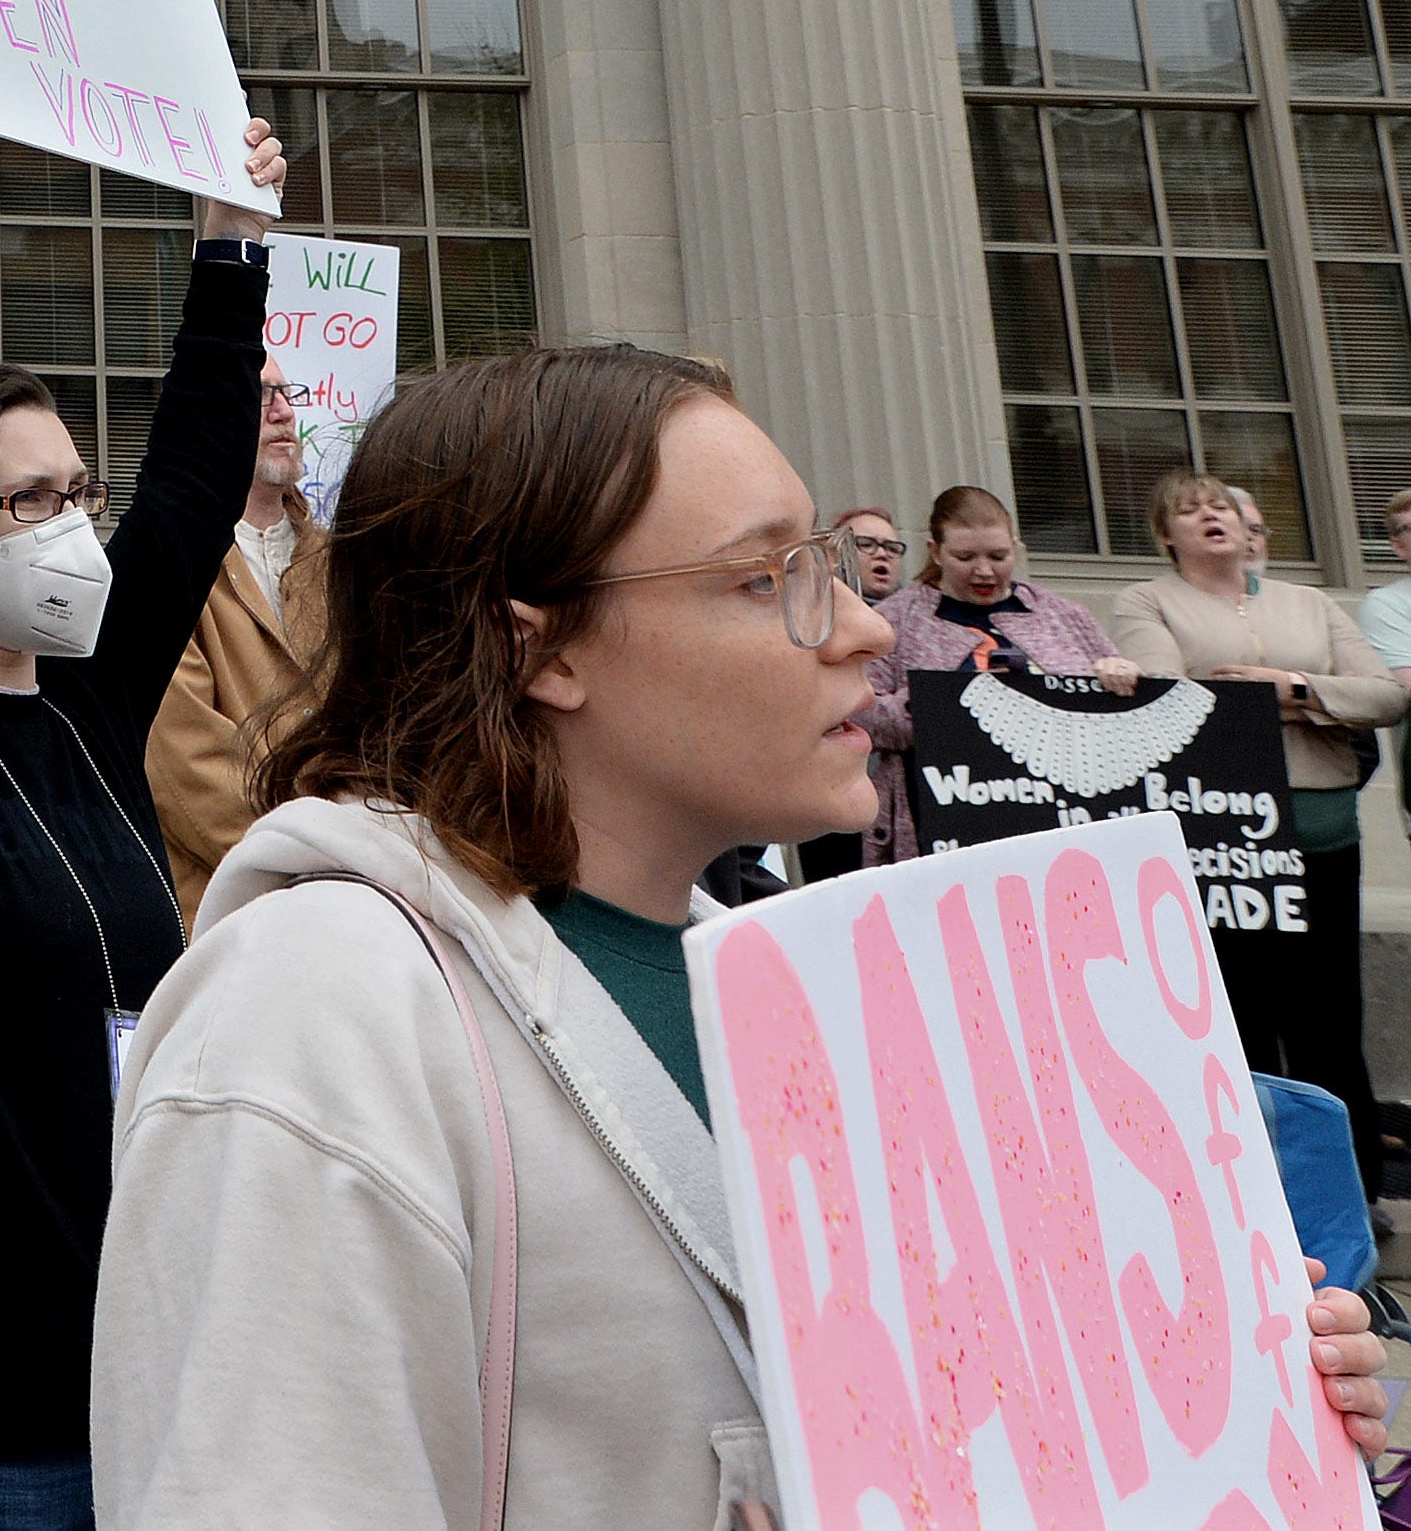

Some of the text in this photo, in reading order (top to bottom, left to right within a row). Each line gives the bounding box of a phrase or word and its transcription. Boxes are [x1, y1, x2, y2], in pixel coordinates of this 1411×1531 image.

[29, 60, 233, 194] VOTE!
[323, 312, 378, 349] GO
[309, 372, 358, 424] tly
[922, 765, 1280, 840] Women Belong
[1206, 884, 1309, 933] ADE
